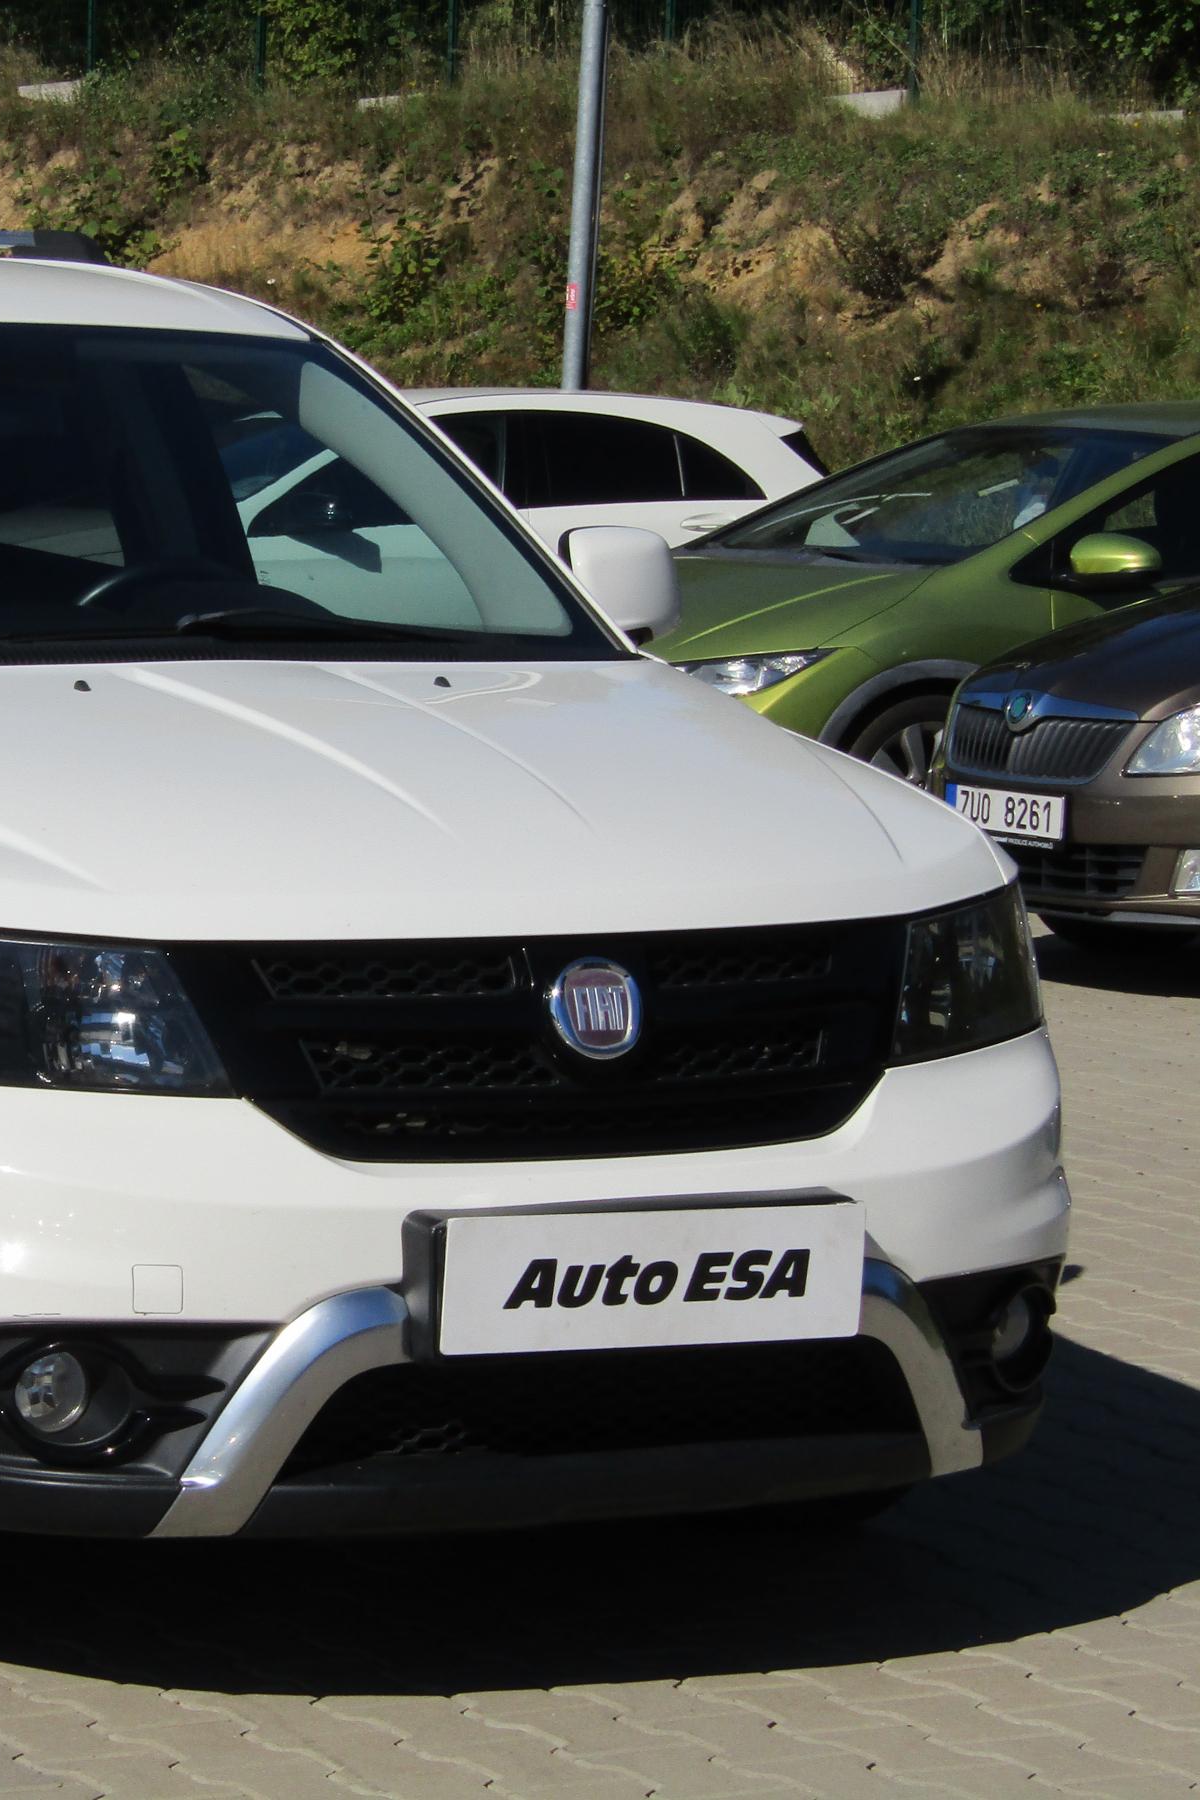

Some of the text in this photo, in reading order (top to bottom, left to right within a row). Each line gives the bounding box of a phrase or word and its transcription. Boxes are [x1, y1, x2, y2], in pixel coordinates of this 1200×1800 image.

[1004, 796, 1051, 832] 8261
[573, 986, 624, 1031] FIAT
[503, 1249, 811, 1309] Auto ESA
